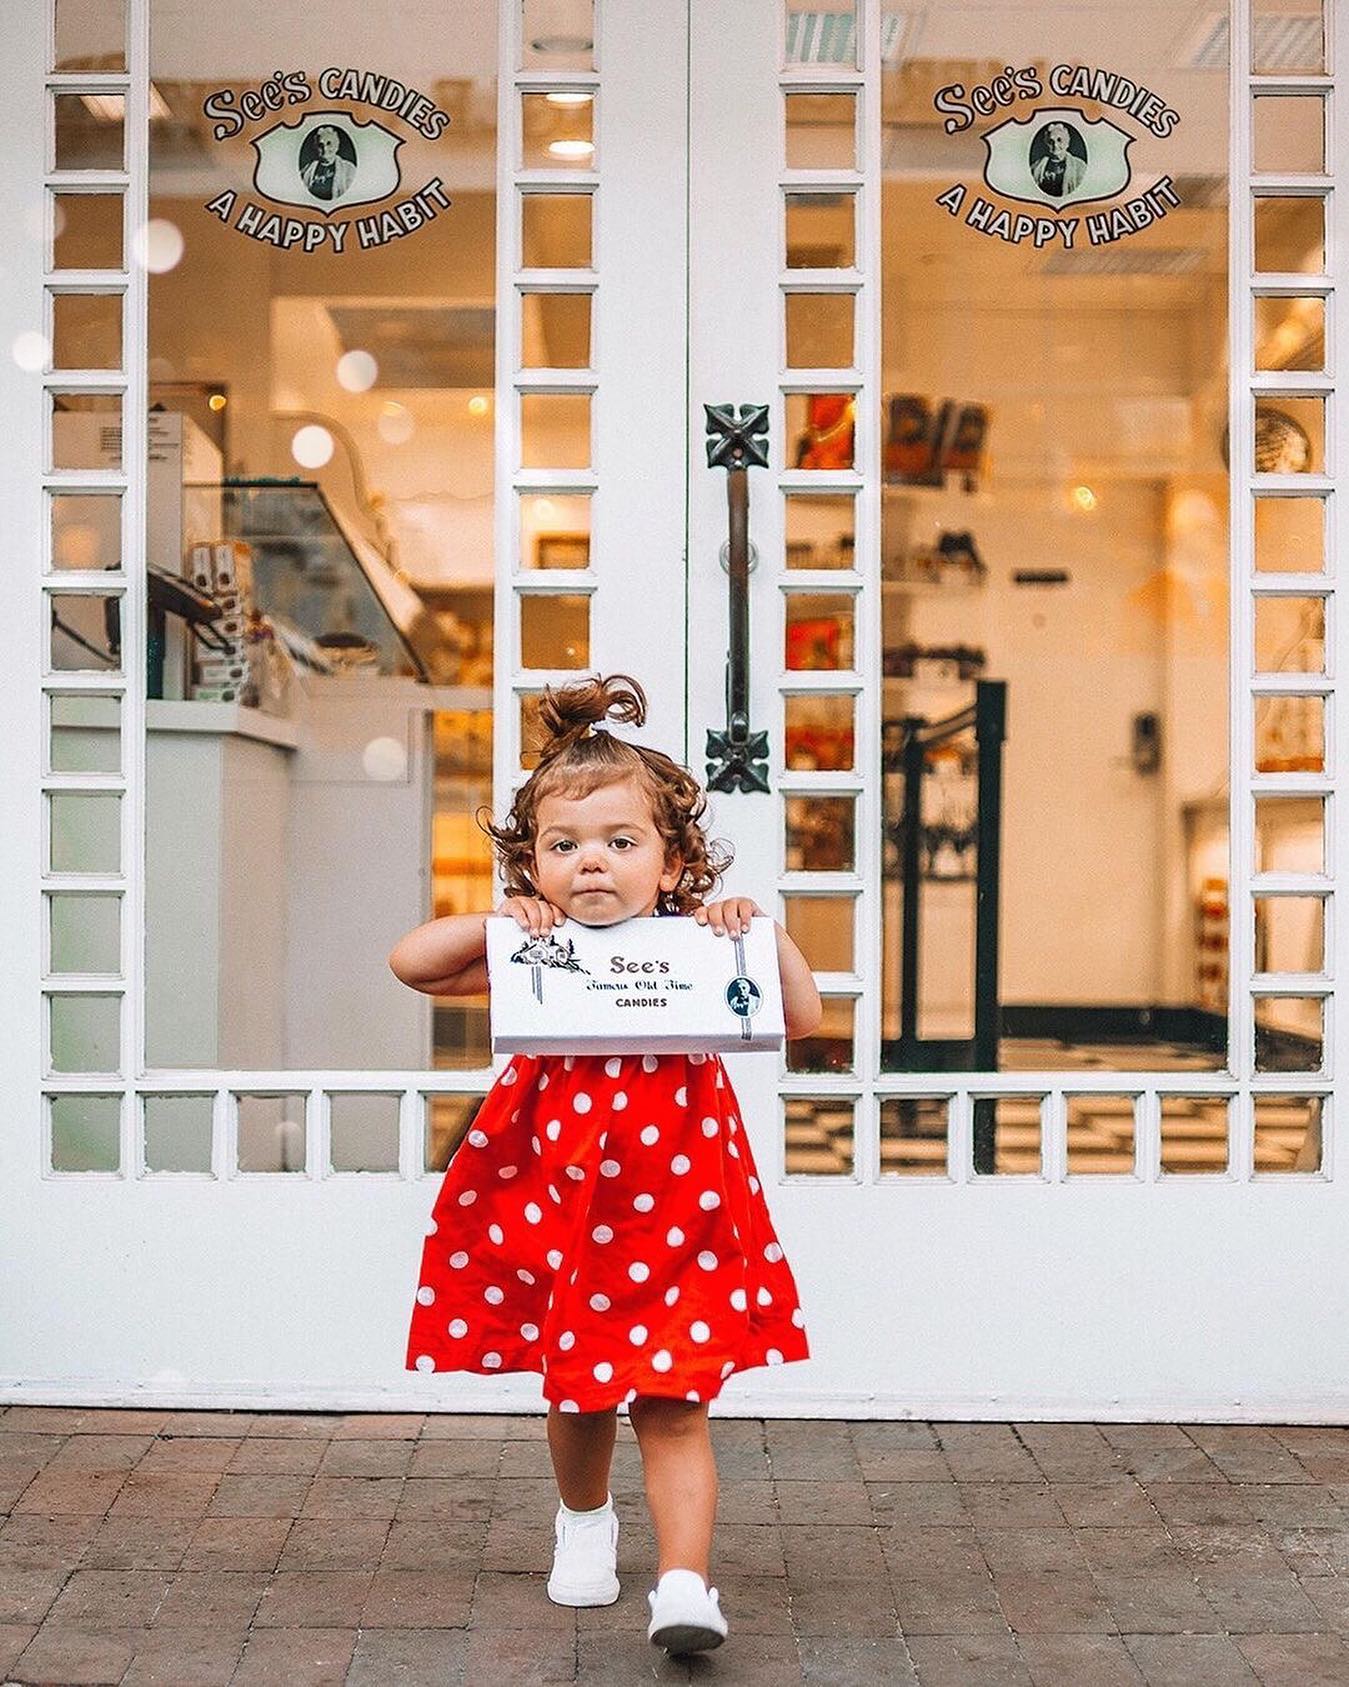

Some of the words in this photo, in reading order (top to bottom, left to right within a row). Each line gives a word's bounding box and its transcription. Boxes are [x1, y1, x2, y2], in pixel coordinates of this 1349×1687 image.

[203, 71, 311, 140] See's
[319, 68, 450, 140] CANDIES
[934, 66, 1042, 134] See's
[1050, 64, 1180, 138] CANDIES
[204, 190, 237, 223] A
[236, 204, 350, 252] HAPPY
[356, 177, 451, 249] HABIT
[936, 183, 967, 216] A
[966, 198, 1079, 249] HAPPY
[1086, 176, 1181, 245] HABIT
[610, 956, 670, 974] See's
[635, 980, 658, 991] Old
[615, 998, 668, 1007] CANDIES
